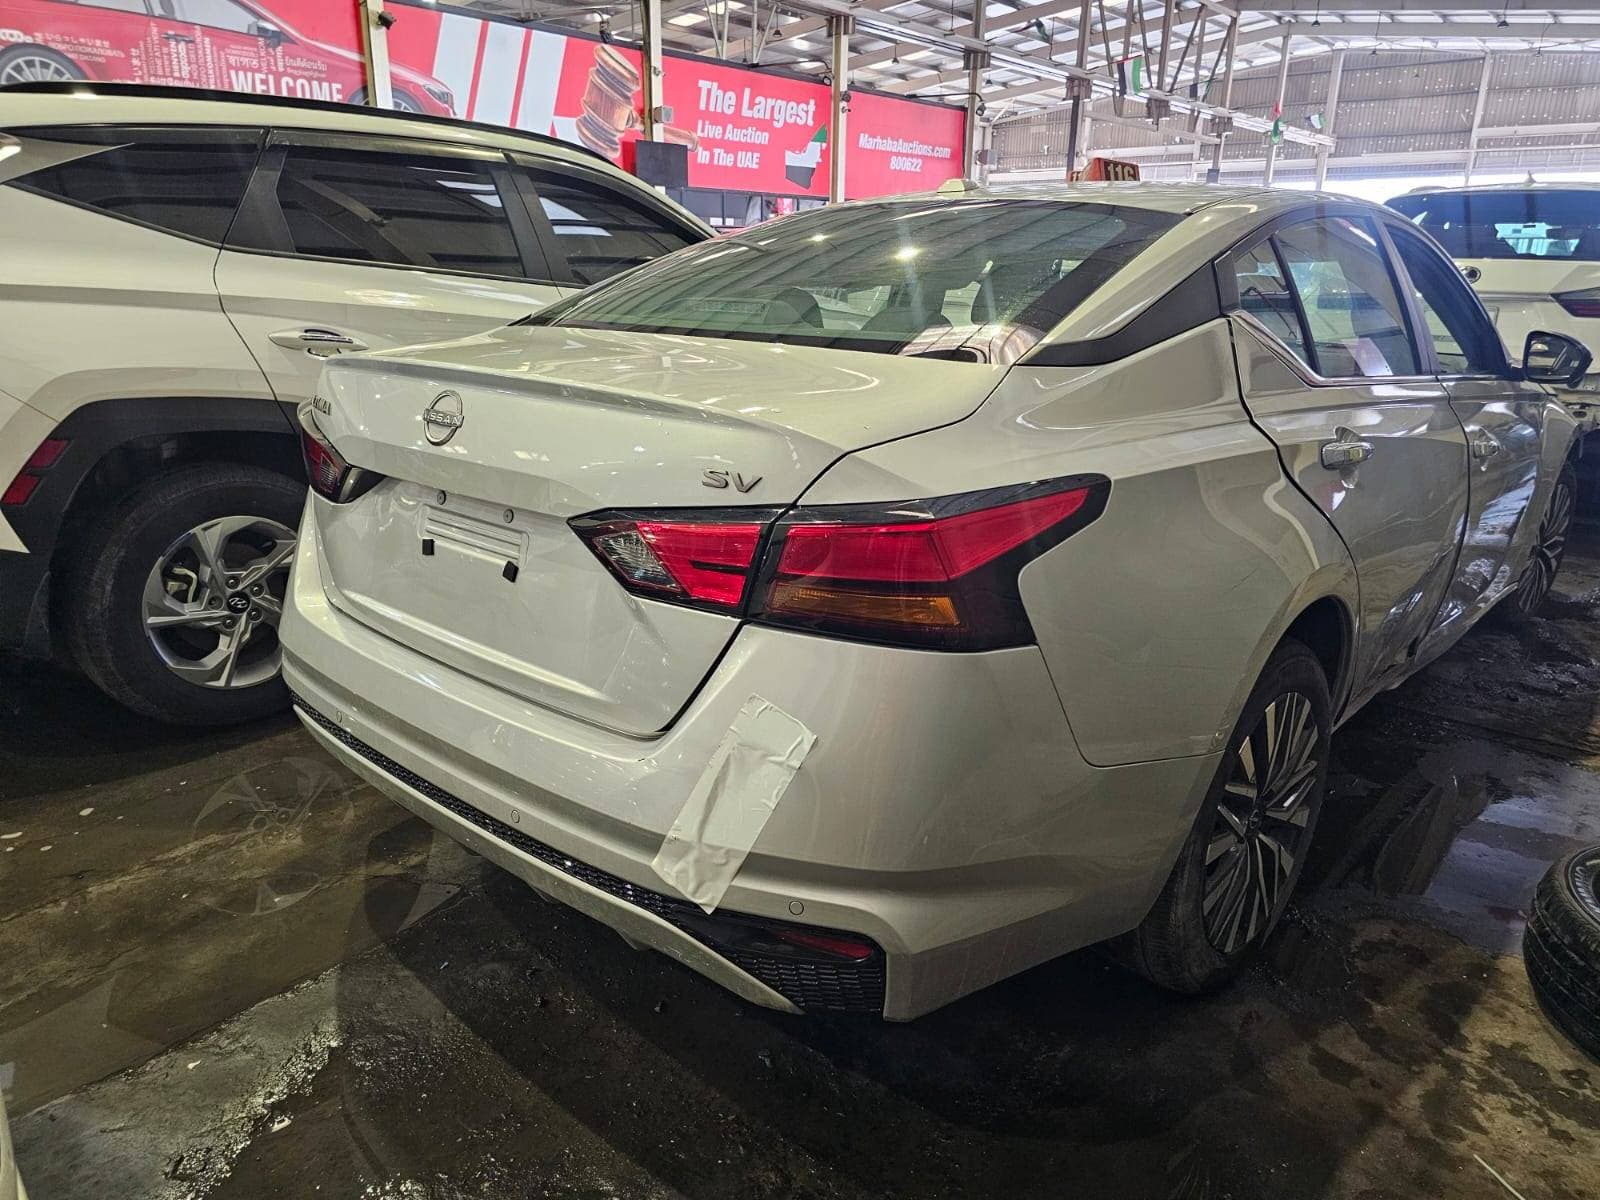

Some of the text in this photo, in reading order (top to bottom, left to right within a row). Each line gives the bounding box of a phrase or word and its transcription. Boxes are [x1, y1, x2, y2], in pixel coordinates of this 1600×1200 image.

[229, 69, 343, 103] WELCOME
[698, 80, 816, 128] The Largest
[697, 119, 769, 145] Live Auction
[697, 147, 761, 169] In The UAE
[859, 133, 952, 158] MarhabaAuctions.com
[890, 156, 922, 172] 800622
[701, 469, 764, 494] SV
